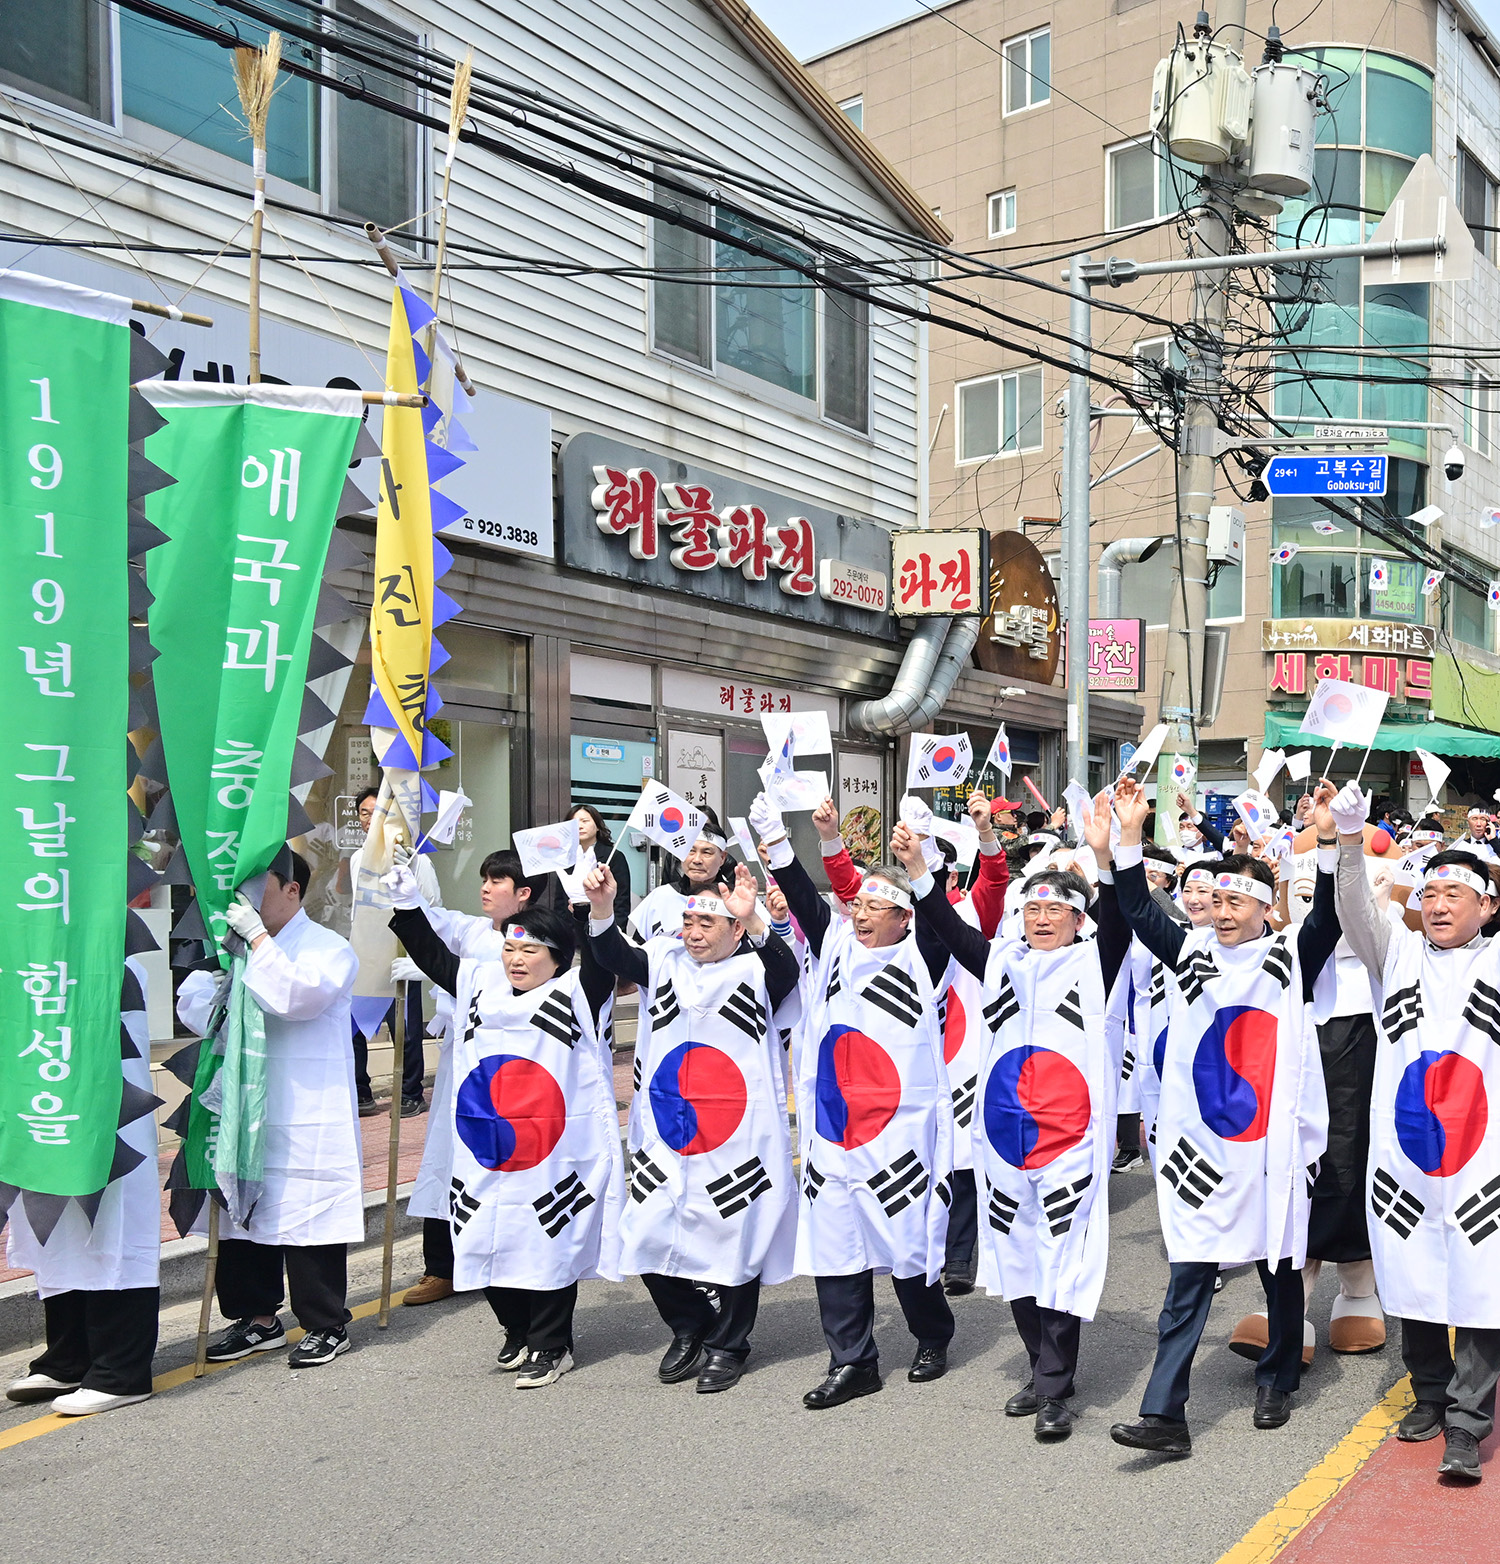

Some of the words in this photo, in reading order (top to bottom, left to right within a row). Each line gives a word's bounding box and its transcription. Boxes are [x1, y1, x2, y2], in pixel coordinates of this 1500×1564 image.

[1315, 459, 1382, 478] 고복수길
[1327, 480, 1381, 492] Goboksu-gil
[17, 377, 76, 698] 1919년
[478, 519, 538, 546] 929.3838
[594, 465, 817, 596] 해물파전
[222, 447, 302, 693] 애국과
[846, 568, 869, 584] 주문예약
[900, 548, 972, 610] 파전
[832, 578, 884, 607] 292-0078
[1375, 600, 1415, 613] 4454.0045
[1348, 624, 1425, 650] 세화마트
[1089, 676, 1136, 687] 9277-4403
[842, 776, 879, 795] 해물파전
[15, 743, 77, 924] 그날의
[1453, 867, 1472, 882] 독립
[880, 885, 900, 900] 독립
[1233, 877, 1254, 893] 독립
[698, 898, 718, 912] 독립
[16, 961, 80, 1145] 함성을
